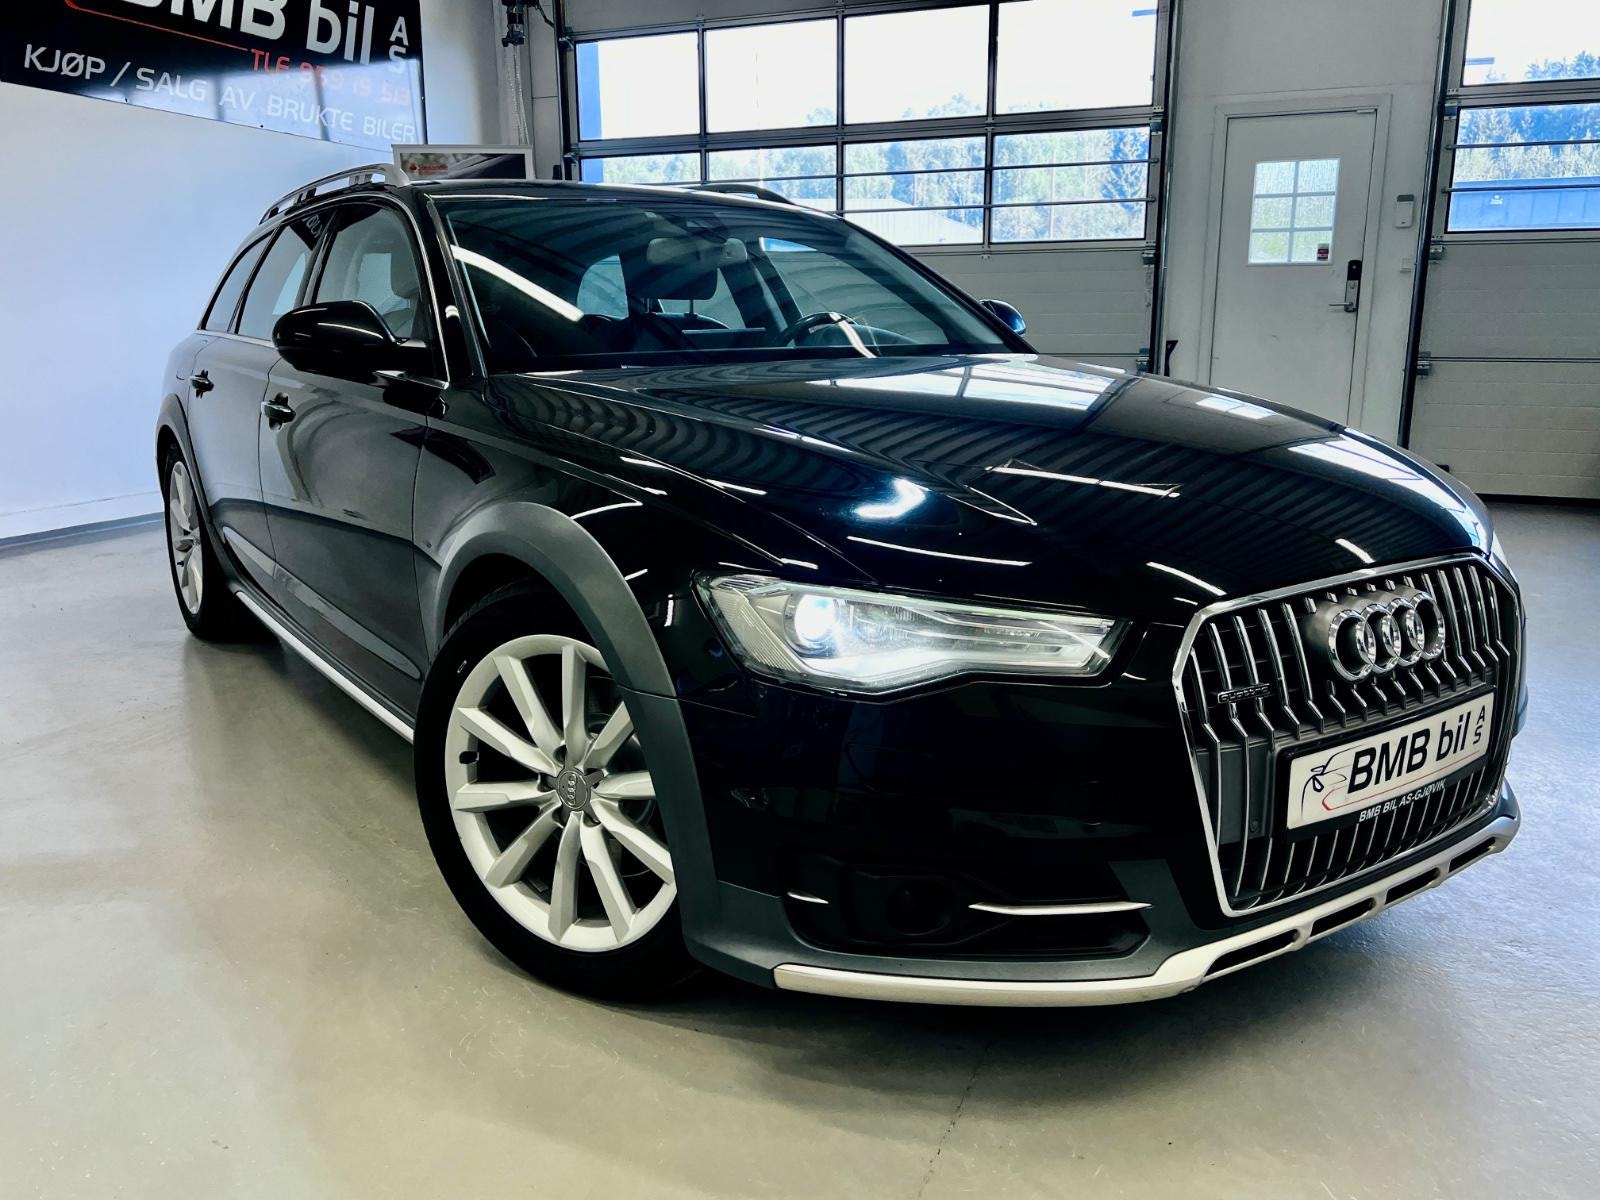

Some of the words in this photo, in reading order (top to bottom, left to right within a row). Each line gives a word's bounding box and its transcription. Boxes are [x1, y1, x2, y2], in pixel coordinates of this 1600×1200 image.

[306, 0, 375, 65] bil
[23, 43, 106, 80] KJØP
[135, 67, 208, 101] SALG
[218, 86, 257, 111] AV
[267, 95, 354, 131] BRUKTE
[362, 115, 416, 143] BILER
[1347, 727, 1431, 795] BMB
[1435, 710, 1472, 762] bil
[1359, 804, 1382, 823] BMB
[1382, 799, 1399, 814] BIL
